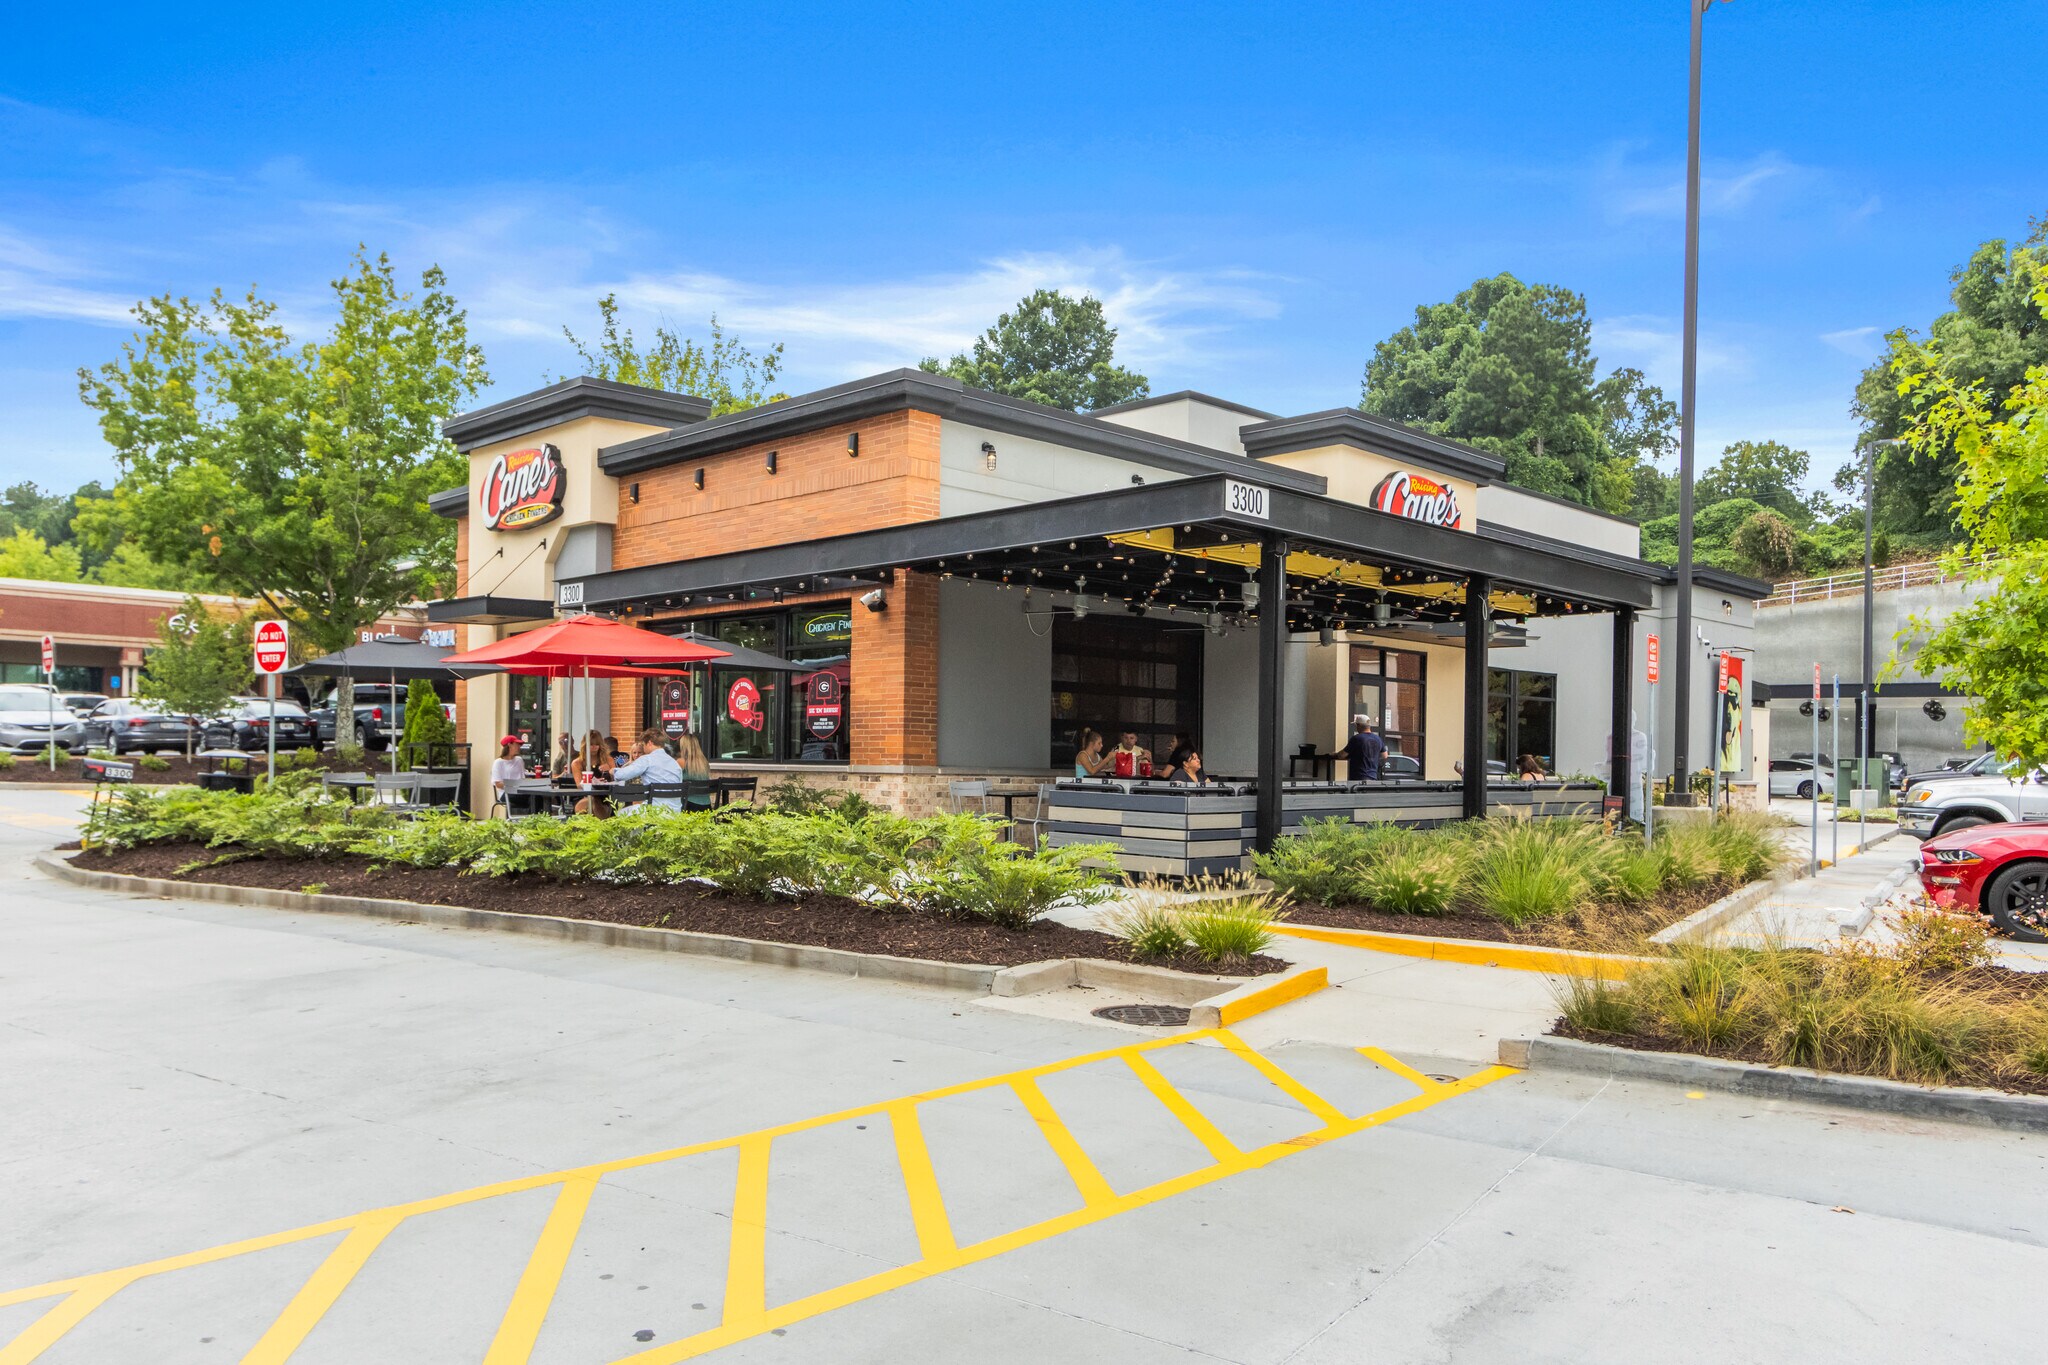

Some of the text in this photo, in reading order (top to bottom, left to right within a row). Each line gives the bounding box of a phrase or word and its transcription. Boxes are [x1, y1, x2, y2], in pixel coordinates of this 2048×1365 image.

[482, 443, 557, 528] Cane's
[1410, 478, 1438, 496] Raising
[1232, 484, 1263, 514] 3300
[1383, 471, 1461, 525] Cane's
[564, 585, 580, 602] 3300
[809, 621, 836, 633] CHICKEN
[260, 631, 283, 641] DO NOT
[261, 654, 281, 663] ENTER
[106, 768, 132, 778] 3300
